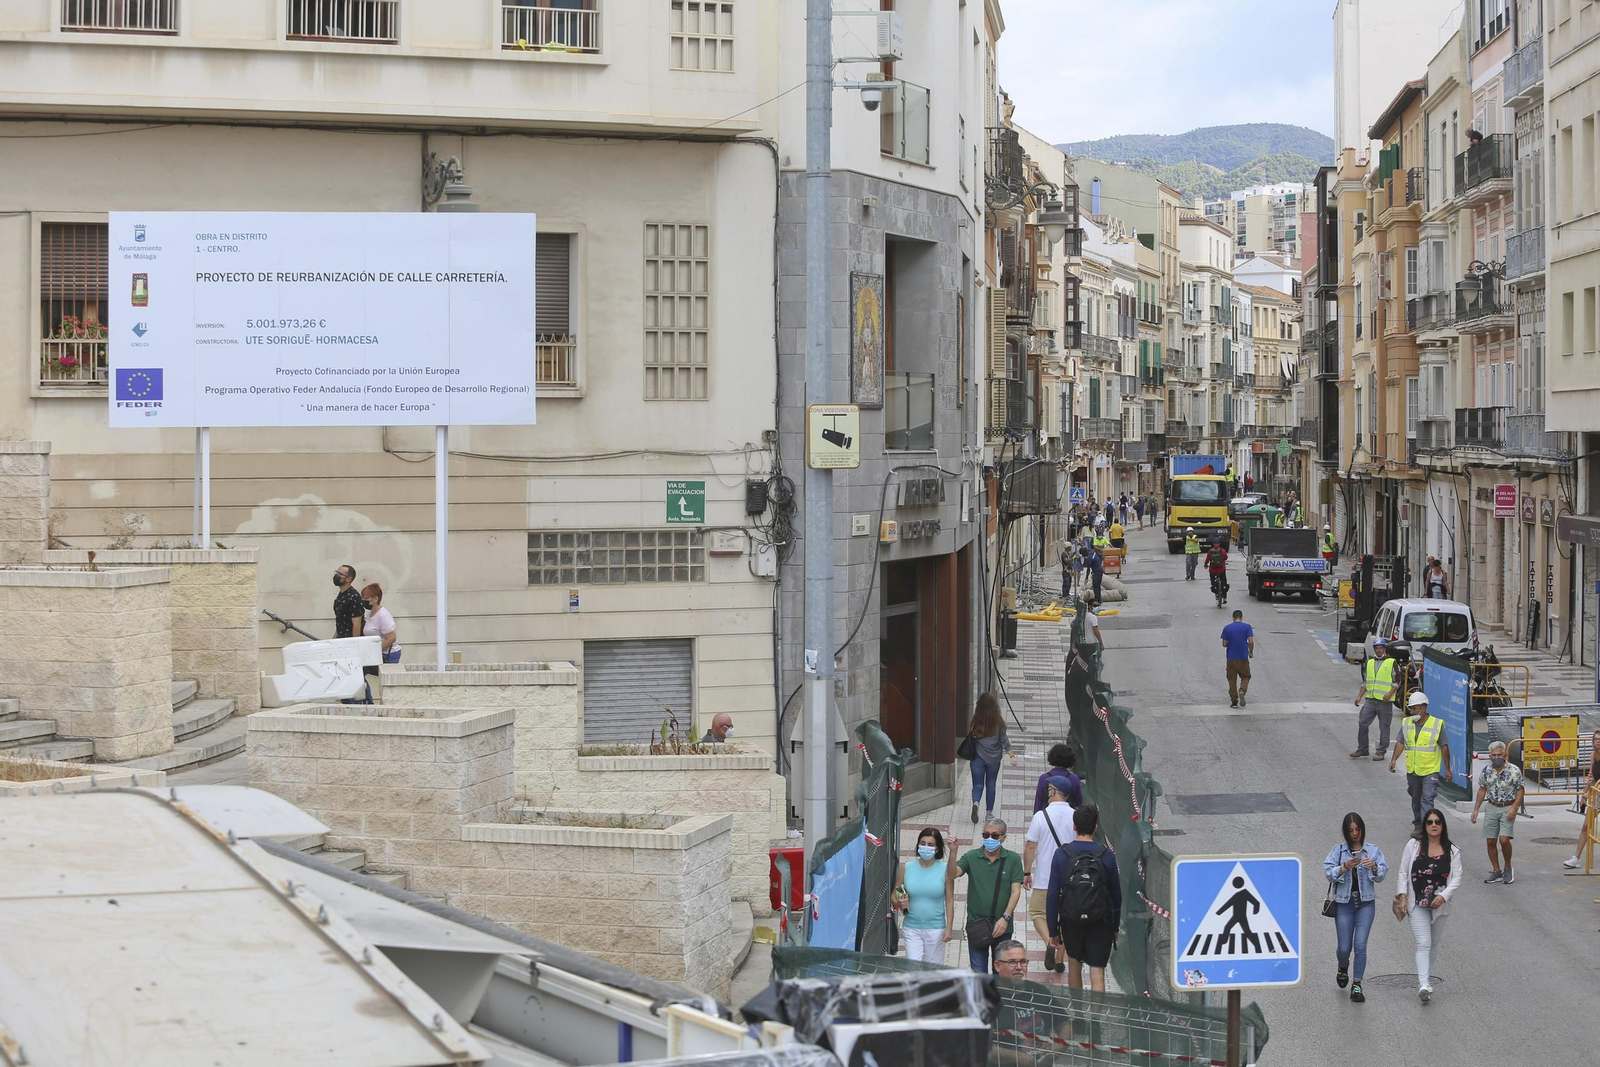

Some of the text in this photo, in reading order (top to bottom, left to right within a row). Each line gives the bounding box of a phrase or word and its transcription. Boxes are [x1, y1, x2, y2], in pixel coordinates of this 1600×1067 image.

[196, 270, 508, 283] PROYECTO DE REURBANIZACIÓN DE CALLE CARRETERÍA.
[247, 319, 326, 329] 5.001.973,26 €
[246, 336, 264, 345] UTE
[316, 336, 379, 344] HORMACESA
[276, 367, 312, 377] Proyecto
[314, 367, 370, 375] Cofinanciado
[388, 367, 396, 375] la
[399, 367, 423, 375] Unión
[425, 367, 460, 376] Europea
[205, 386, 247, 396] Programa
[249, 386, 291, 395] Operativo
[293, 385, 317, 394] Feder
[319, 385, 361, 393] Andalucía
[363, 385, 393, 394] (Fondo
[395, 385, 430, 394] Europeo
[490, 385, 529, 394] Regional)
[400, 403, 430, 412] Europa
